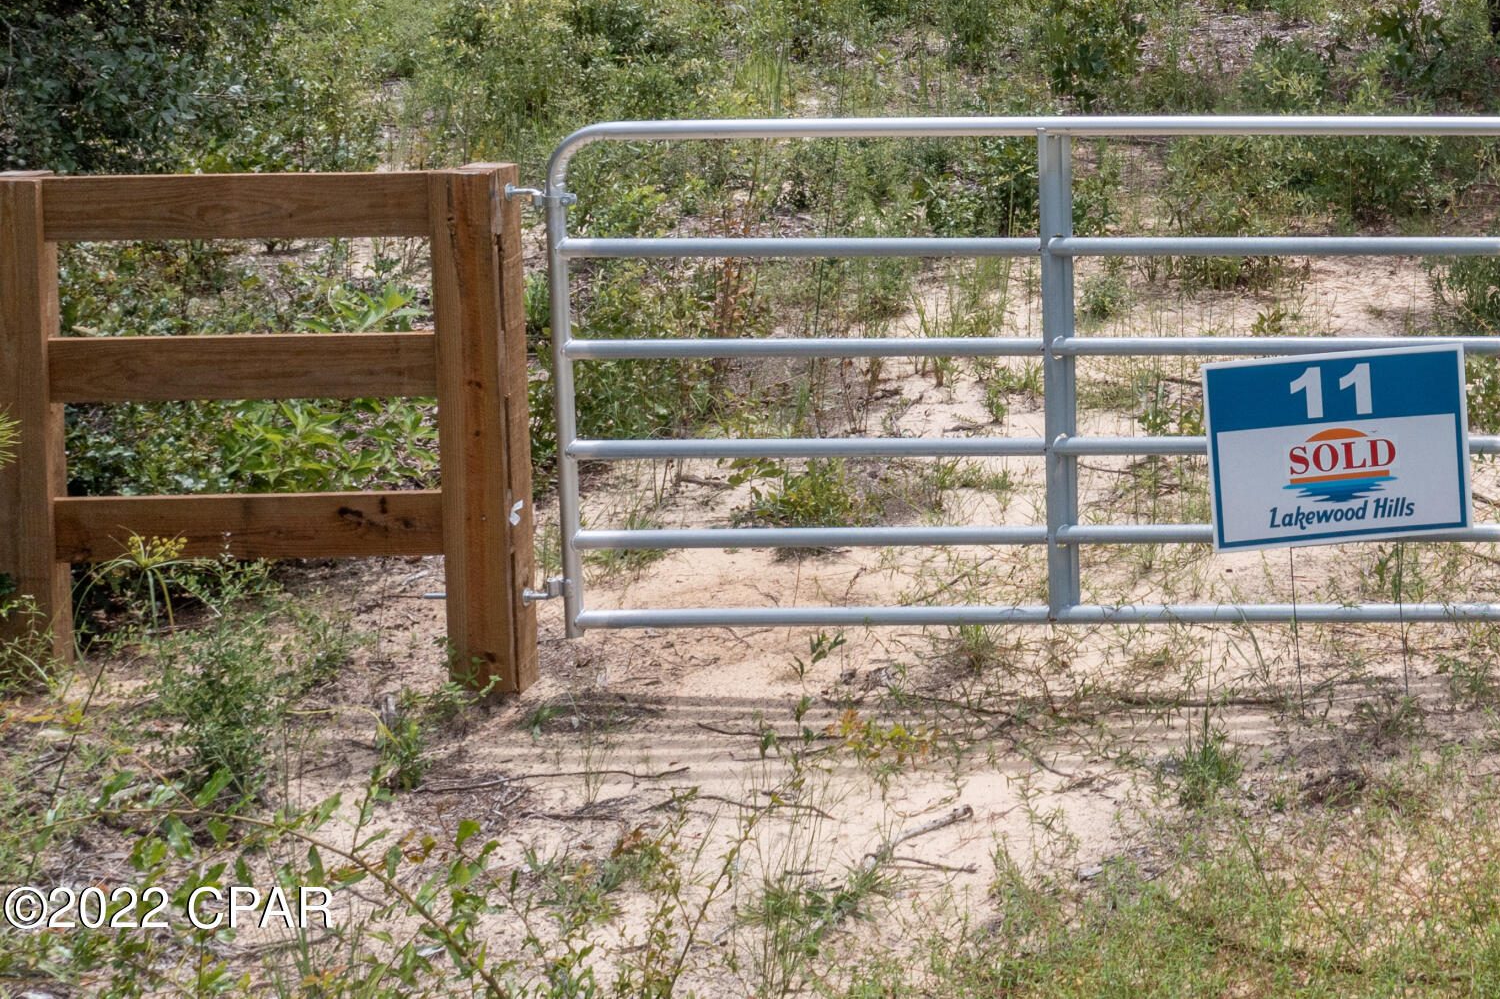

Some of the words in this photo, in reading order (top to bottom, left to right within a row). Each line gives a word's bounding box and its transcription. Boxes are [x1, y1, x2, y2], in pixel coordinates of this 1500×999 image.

[1289, 362, 1373, 419] 11
[1289, 438, 1396, 475] SOLD
[1269, 498, 1368, 530] Lakewood
[1373, 497, 1415, 518] Hills
